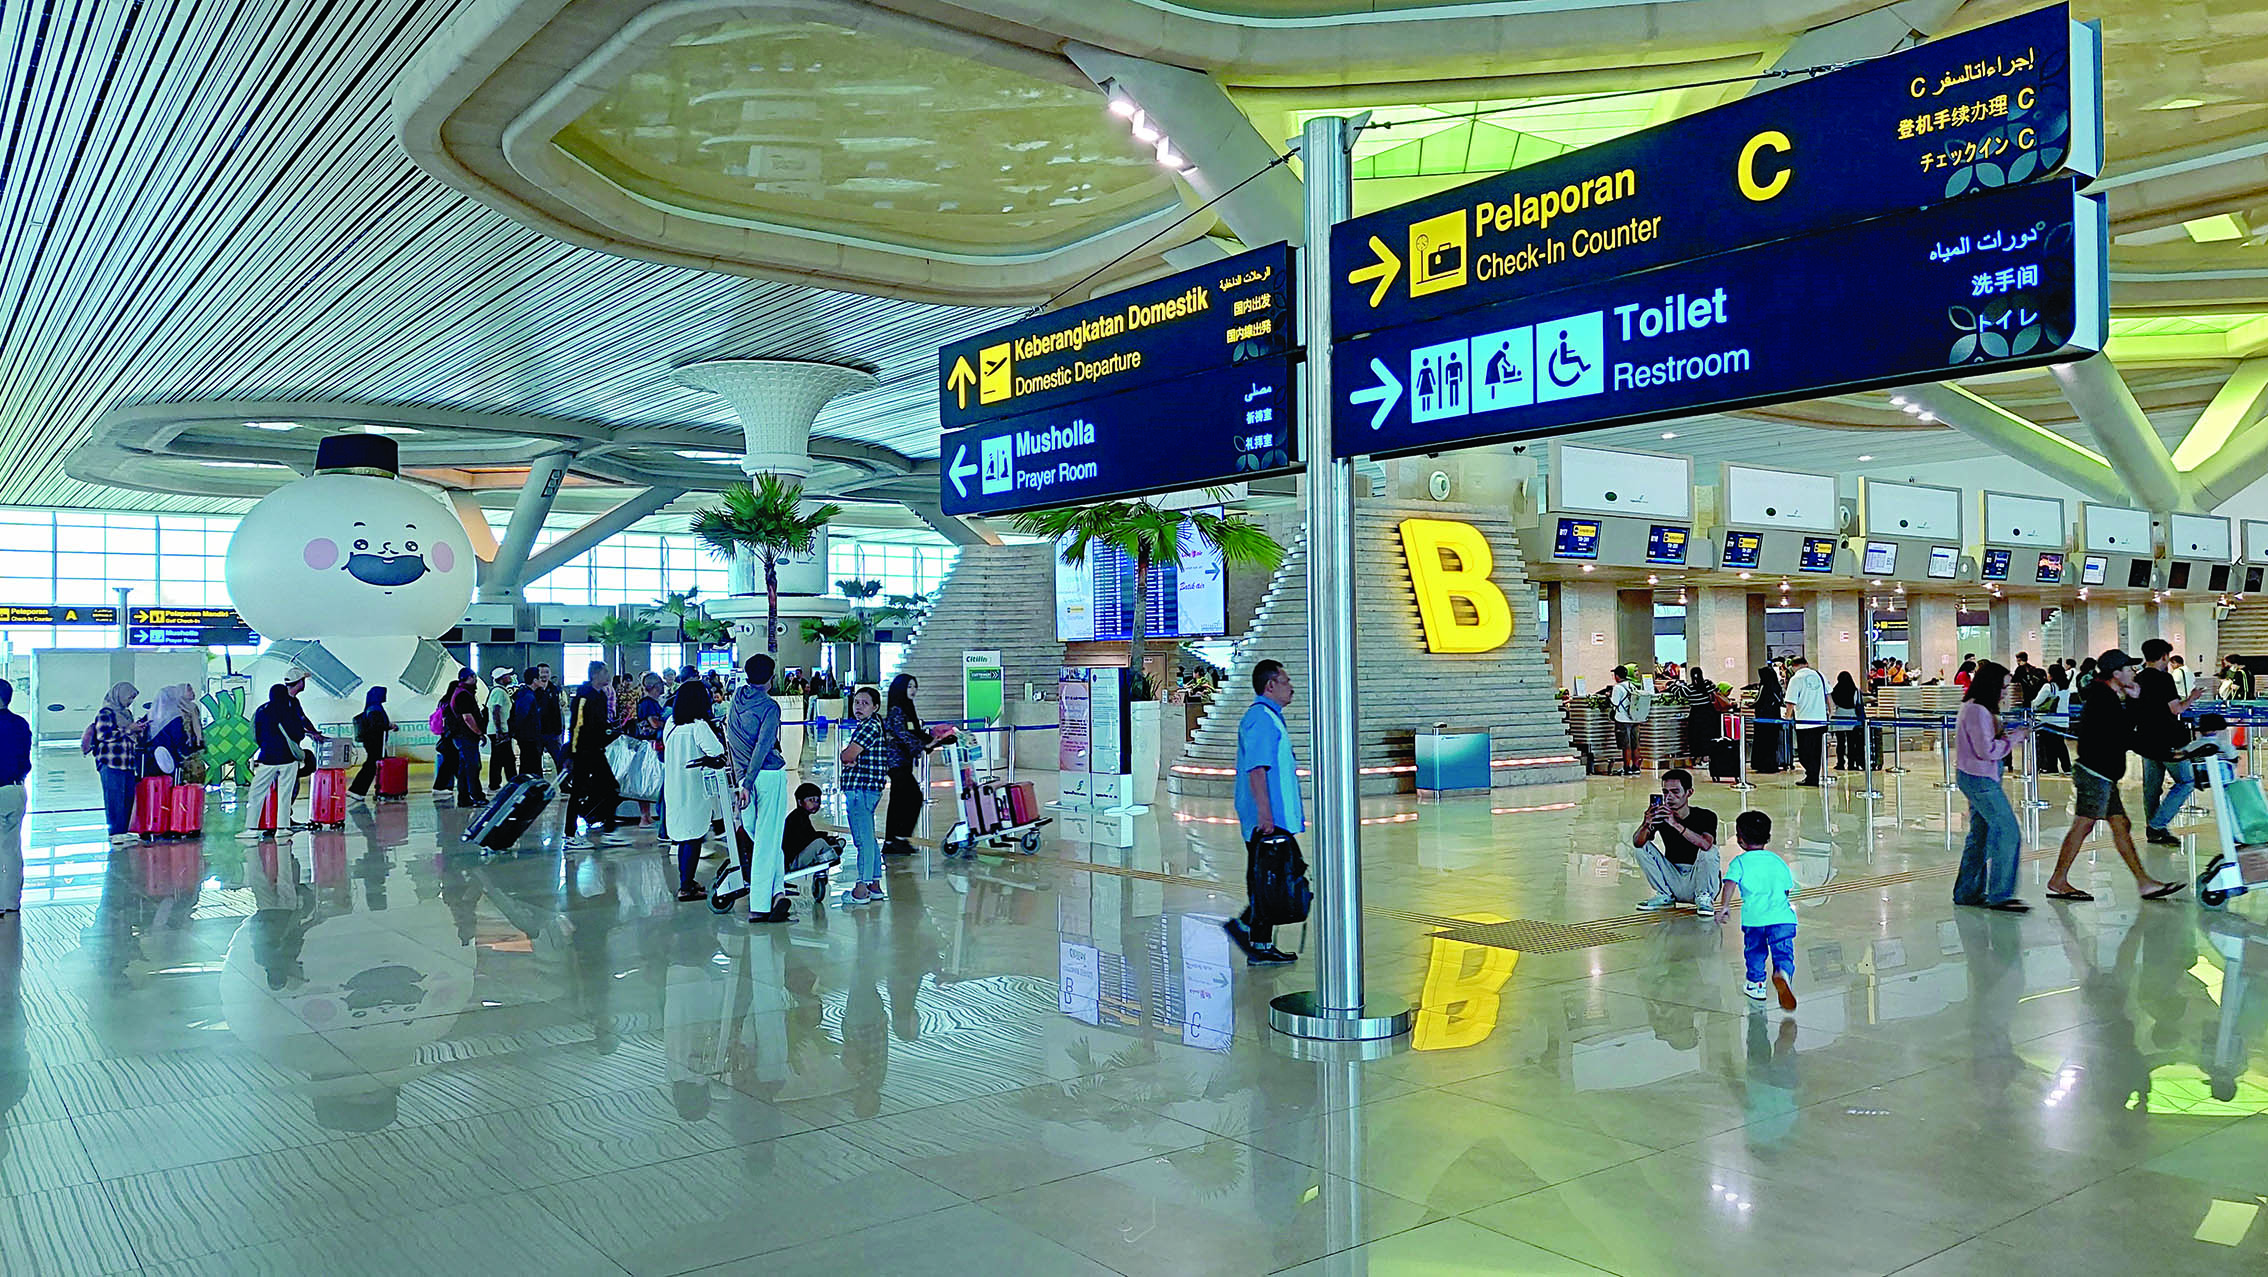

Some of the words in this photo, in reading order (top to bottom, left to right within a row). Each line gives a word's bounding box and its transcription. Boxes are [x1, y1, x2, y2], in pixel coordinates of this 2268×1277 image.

[1910, 77, 1926, 98] C
[1897, 94, 2008, 140] 登机手续办理
[2018, 87, 2035, 110] C
[1920, 137, 2009, 172] チェックイン
[2018, 127, 2035, 150] C
[1476, 168, 1635, 238] Pelaporan
[1737, 130, 1791, 201] C
[1476, 239, 1565, 282] Check-In
[1571, 215, 1661, 255] Counter
[1971, 264, 2038, 296] 洗手间
[1014, 312, 1125, 362] Keberangkatan
[1128, 287, 1209, 331] Domestik
[1234, 293, 1272, 316] 国内出发
[1614, 288, 1728, 342] Toilet
[1979, 308, 2038, 333] トイレ
[1015, 364, 1073, 398] Domestic
[1074, 349, 1142, 384] Departure
[1614, 347, 1750, 391] Restroom
[1016, 419, 1096, 458] Musholla
[1017, 469, 1057, 491] Prayer
[1059, 459, 1098, 484] Room
[1399, 518, 1513, 653] B
[65, 610, 78, 620] A
